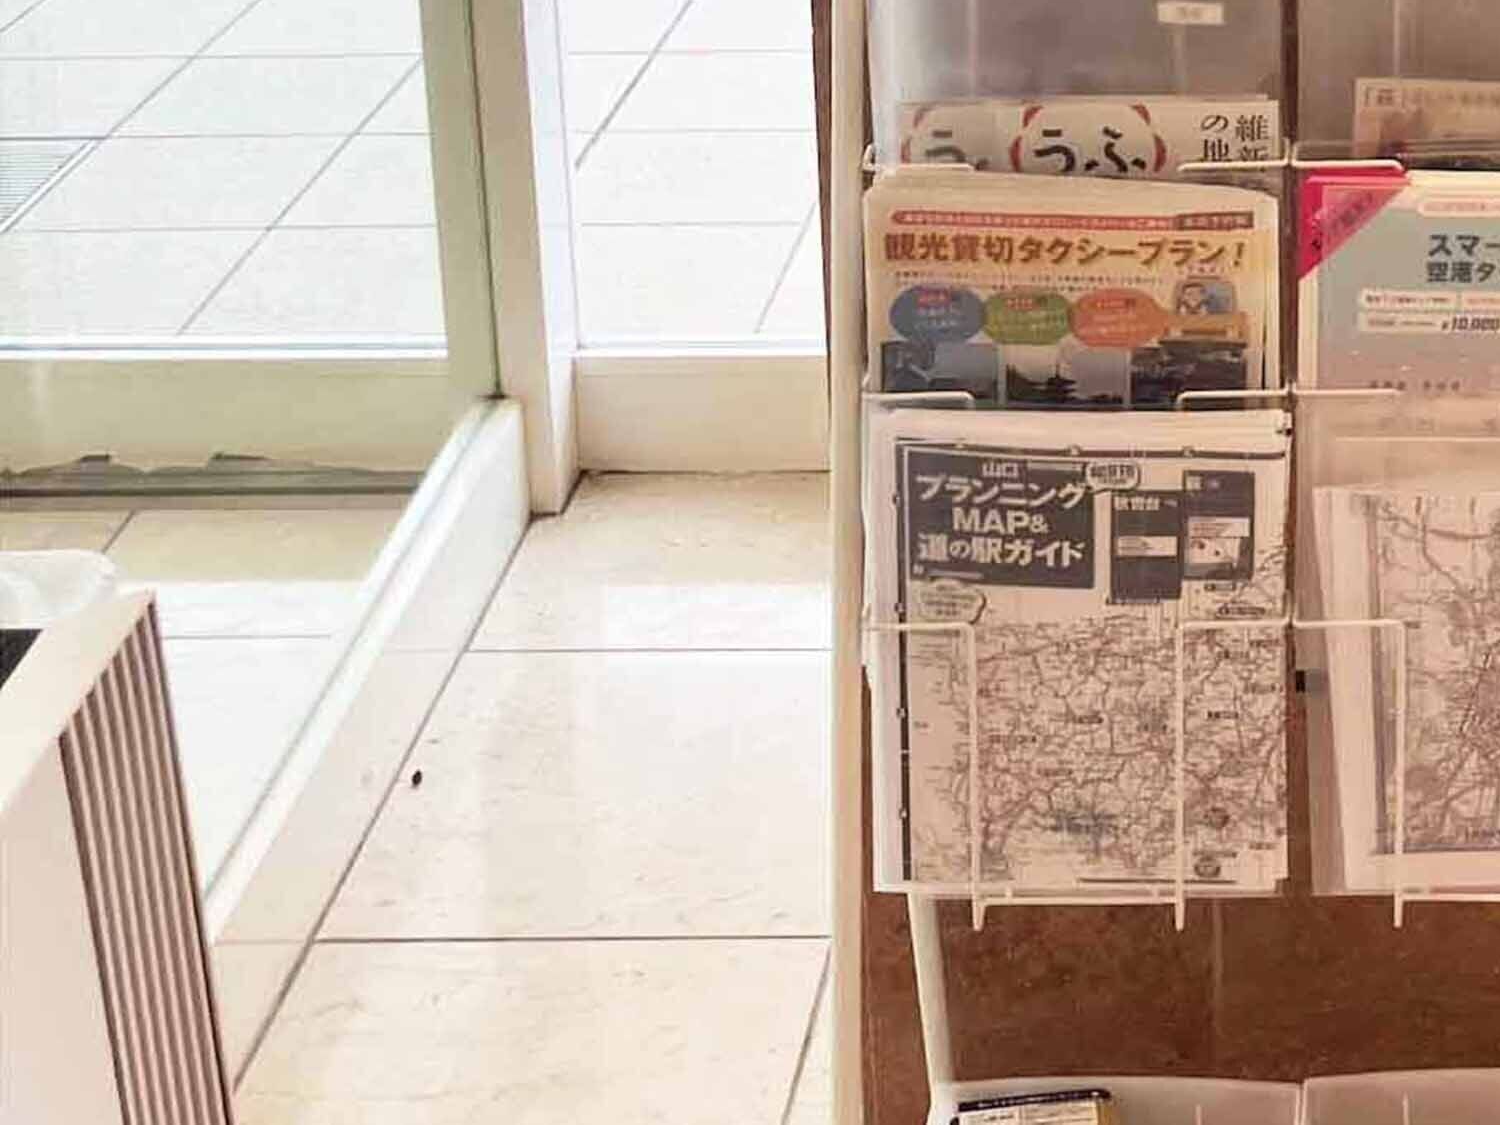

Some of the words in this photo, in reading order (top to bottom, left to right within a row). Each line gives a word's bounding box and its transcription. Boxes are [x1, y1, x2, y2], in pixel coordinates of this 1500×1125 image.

[884, 231, 1245, 268] 観光貸切タクシープラン!
[981, 461, 1019, 478] 山口
[916, 474, 1087, 509] プランニング
[952, 506, 1049, 535] MAP&
[917, 533, 1086, 567] 道の駅ガイド
